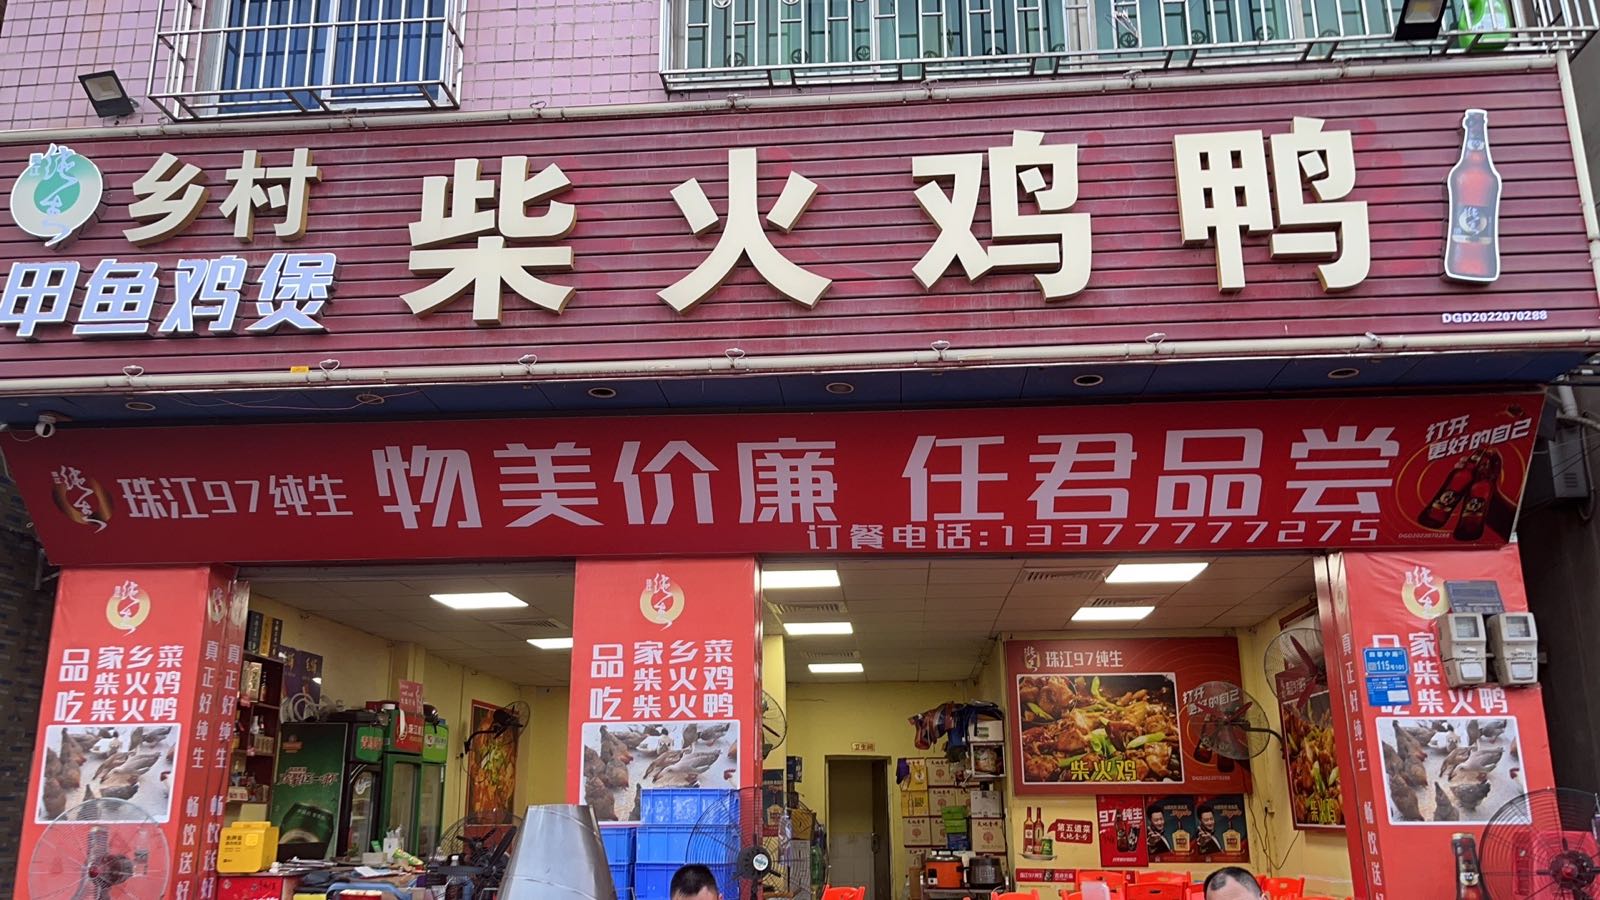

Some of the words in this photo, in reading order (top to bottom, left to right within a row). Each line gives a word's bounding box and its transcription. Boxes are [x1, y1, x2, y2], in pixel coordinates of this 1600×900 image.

[122, 147, 322, 244] 乡村
[401, 116, 1371, 326] 柴火鸡鸭
[0, 252, 337, 339] 甲鱼鸡煲
[1442, 310, 1548, 324] DGD2022070288
[1425, 414, 1470, 443] 打开
[1428, 417, 1532, 461] 更好的自己
[371, 437, 838, 529] 物美价廉
[901, 426, 1399, 521] 任君品尝
[117, 474, 353, 520] 珠江97纯生
[97, 645, 184, 669] 家乡菜
[633, 639, 734, 665] 家乡菜
[1045, 650, 1124, 668] 珠江97纯生
[93, 671, 182, 695] 柴火鸡
[632, 666, 734, 691] 柴火鸡
[91, 698, 178, 722] 柴火鸭
[632, 692, 734, 719] 柴火鸭
[1417, 687, 1508, 714] 柴火鸭
[1070, 760, 1137, 781] 柴火鸡
